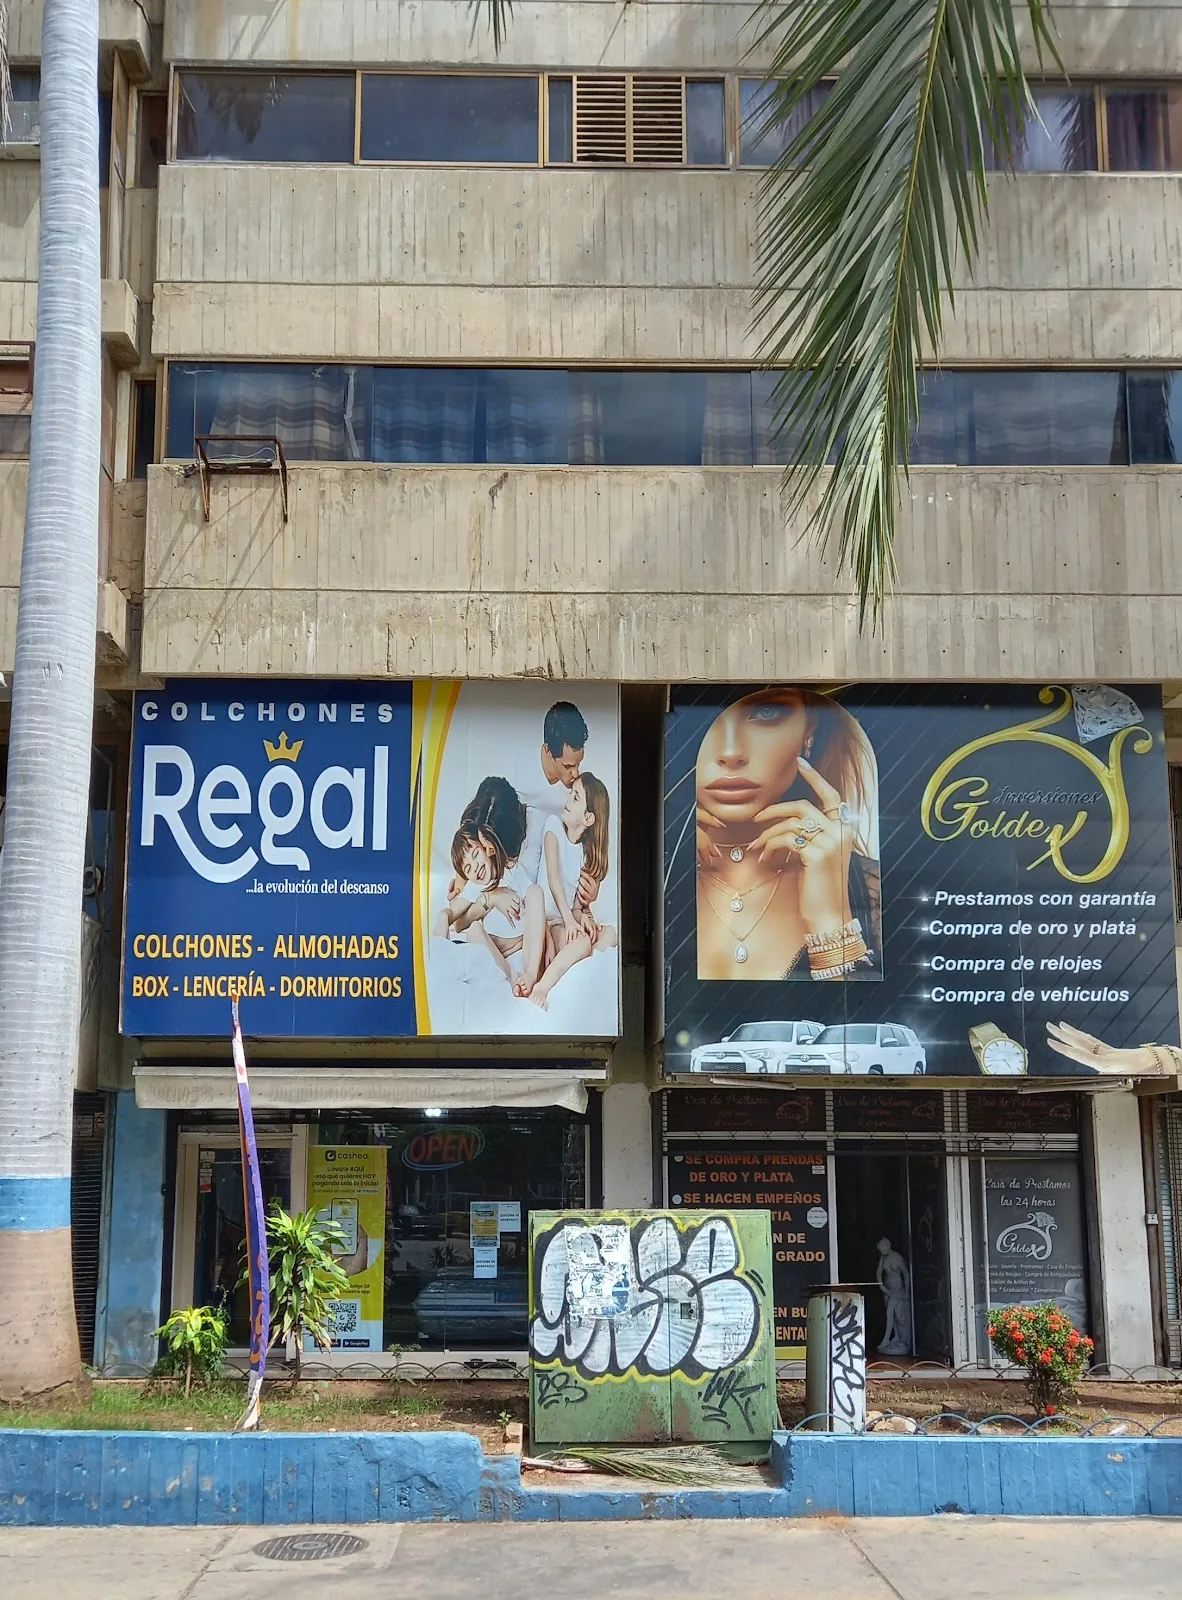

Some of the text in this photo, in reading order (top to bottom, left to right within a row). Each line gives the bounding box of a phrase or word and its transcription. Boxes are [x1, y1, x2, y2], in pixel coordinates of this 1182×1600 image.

[141, 702, 394, 723] COLCHONES
[992, 785, 1103, 805] Inversiones
[140, 744, 389, 884] Regal
[266, 879, 318, 894] evolución
[321, 880, 338, 894] del
[340, 880, 390, 895] descanso
[934, 890, 1034, 906] Prestamos
[1039, 893, 1073, 906] con
[1079, 890, 1156, 909] garantía
[1008, 920, 1033, 935] de
[1038, 922, 1068, 935] oro
[1073, 923, 1085, 938] y
[1088, 920, 1137, 938] plata
[133, 935, 252, 959] COLCHONES
[273, 935, 399, 960] ALMOHADAS
[1010, 955, 1035, 971] de
[1040, 955, 1103, 974] relojes
[132, 975, 169, 998] BOX
[183, 970, 266, 998] LENCERÍA
[280, 974, 402, 998] DORMITORIOS
[1011, 986, 1035, 1002] de
[1040, 986, 1130, 1002] vehículos
[409, 1135, 476, 1163] OPEN
[685, 1155, 824, 1165] SE COMPRA PRENDAS
[689, 1172, 794, 1183] DE ORO Y PLATA
[985, 1178, 1071, 1189] Casa de Prestamos
[683, 1191, 822, 1204] SE HACEN EMPEÑOS
[1000, 1194, 1057, 1207] las 24 horas
[787, 1233, 806, 1244] DE
[775, 1251, 825, 1262] GRADO
